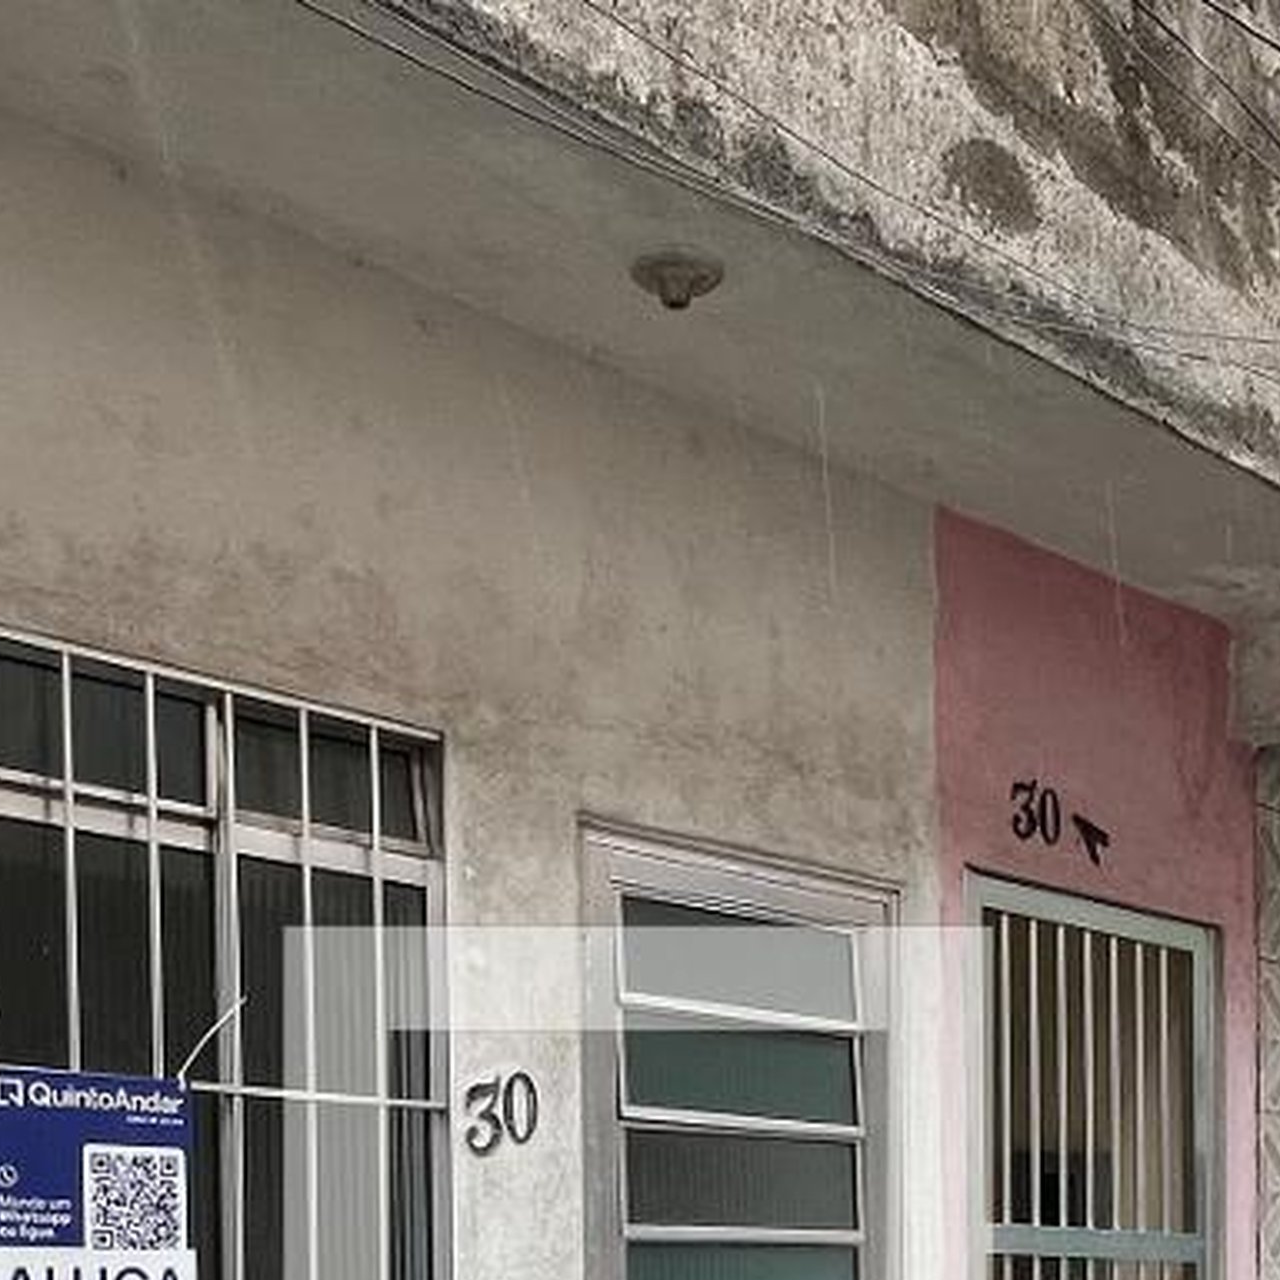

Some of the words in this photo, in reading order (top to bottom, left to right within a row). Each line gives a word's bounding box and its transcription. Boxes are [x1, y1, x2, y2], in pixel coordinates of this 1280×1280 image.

[1010, 779, 1061, 846] 30
[27, 1081, 184, 1114] QuintoAndar
[465, 1071, 538, 1157] 30
